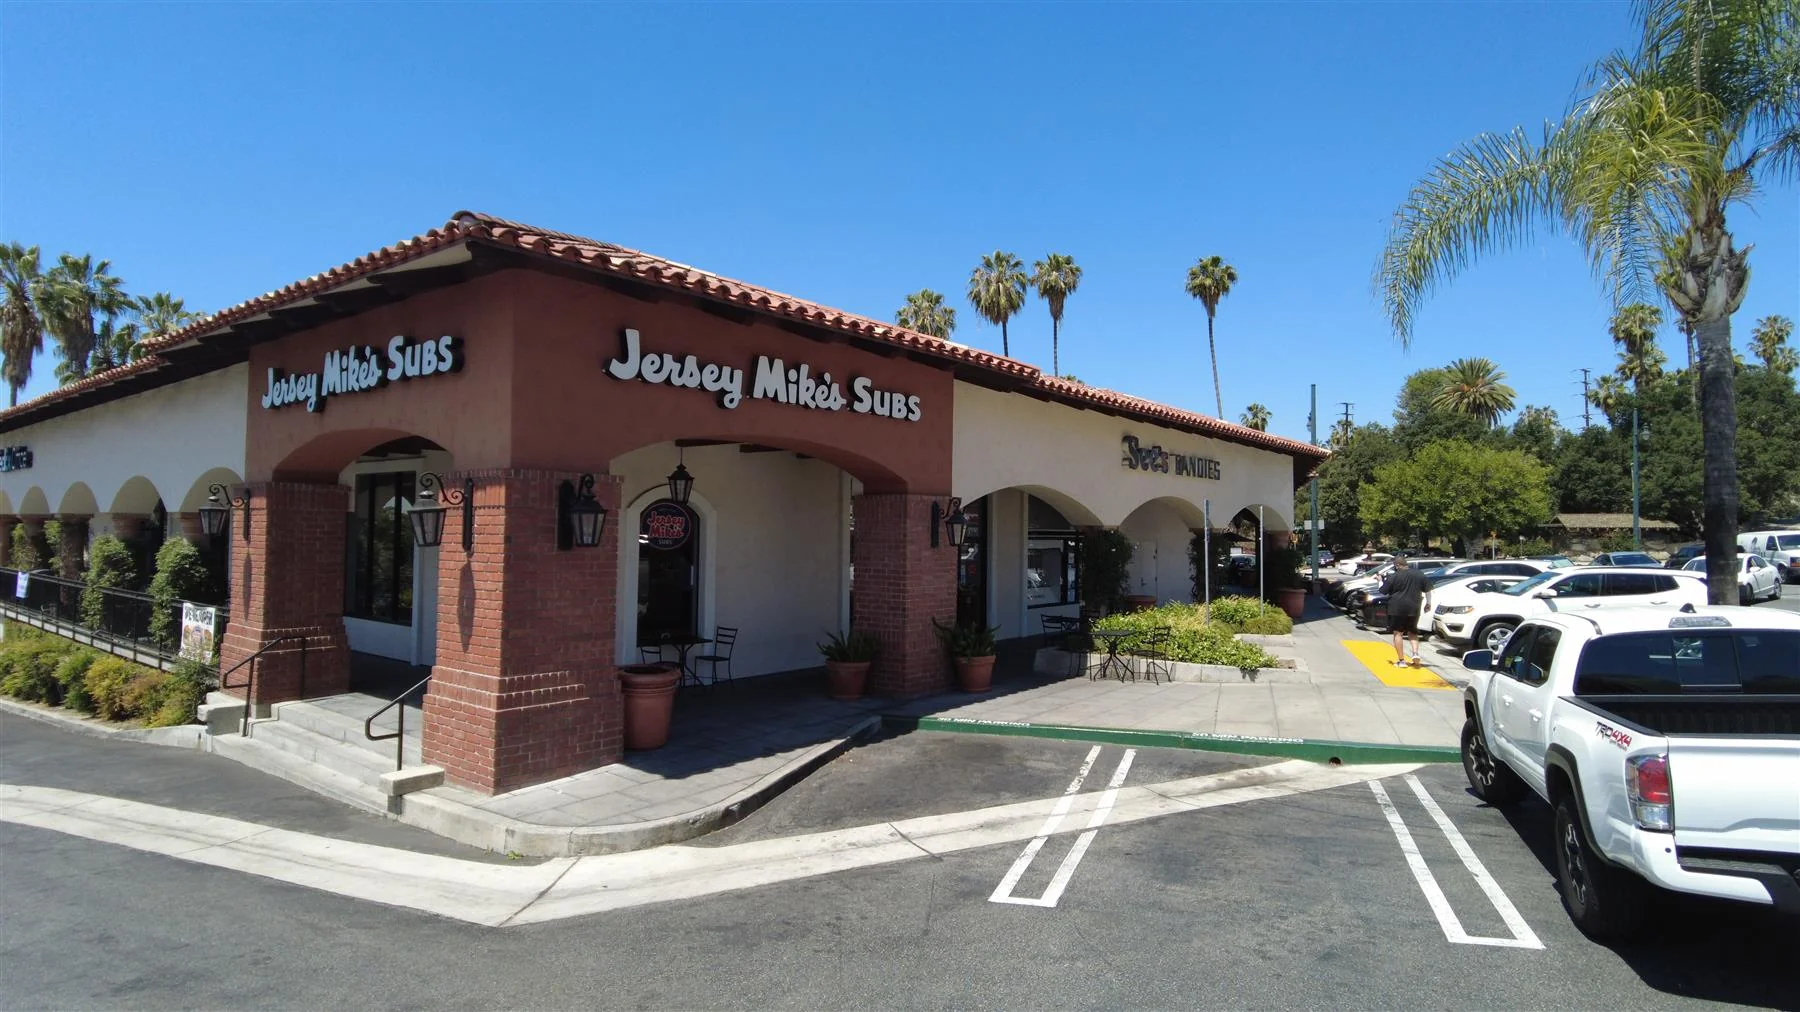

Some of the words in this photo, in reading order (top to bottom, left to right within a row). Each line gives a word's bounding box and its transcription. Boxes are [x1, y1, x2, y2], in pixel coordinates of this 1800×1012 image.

[261, 367, 317, 413] Jersey
[321, 345, 383, 396] Mike's
[609, 328, 743, 409] Jersey
[753, 355, 847, 411] Mike's
[647, 511, 685, 528] Jersey
[649, 523, 685, 539] Mike's
